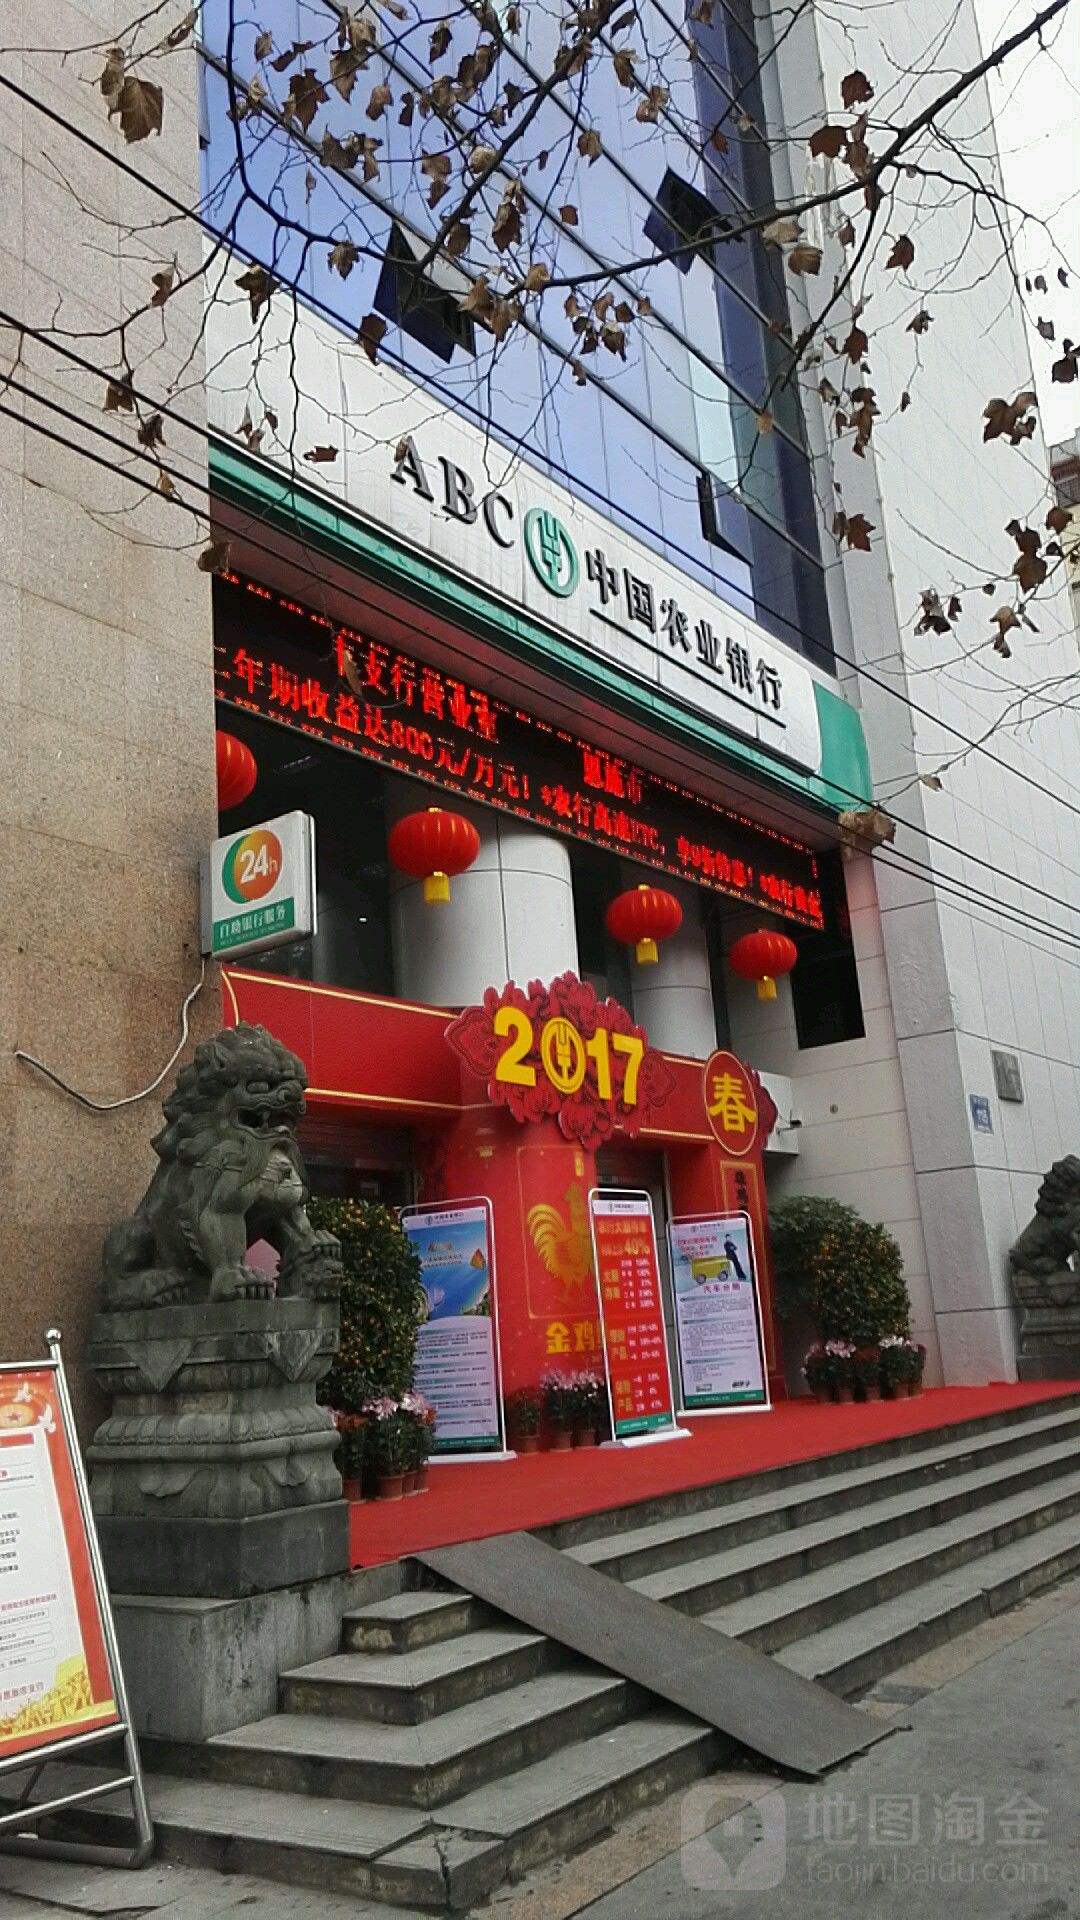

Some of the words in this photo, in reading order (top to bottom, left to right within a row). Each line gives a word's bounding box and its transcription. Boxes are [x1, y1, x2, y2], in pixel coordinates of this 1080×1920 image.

[391, 436, 514, 548] ABC
[586, 549, 782, 710] 中国农业银行
[241, 844, 278, 884] 24h
[494, 1006, 643, 1105] 2017
[709, 1073, 757, 1133] 春
[546, 1321, 602, 1354] 金鸡
